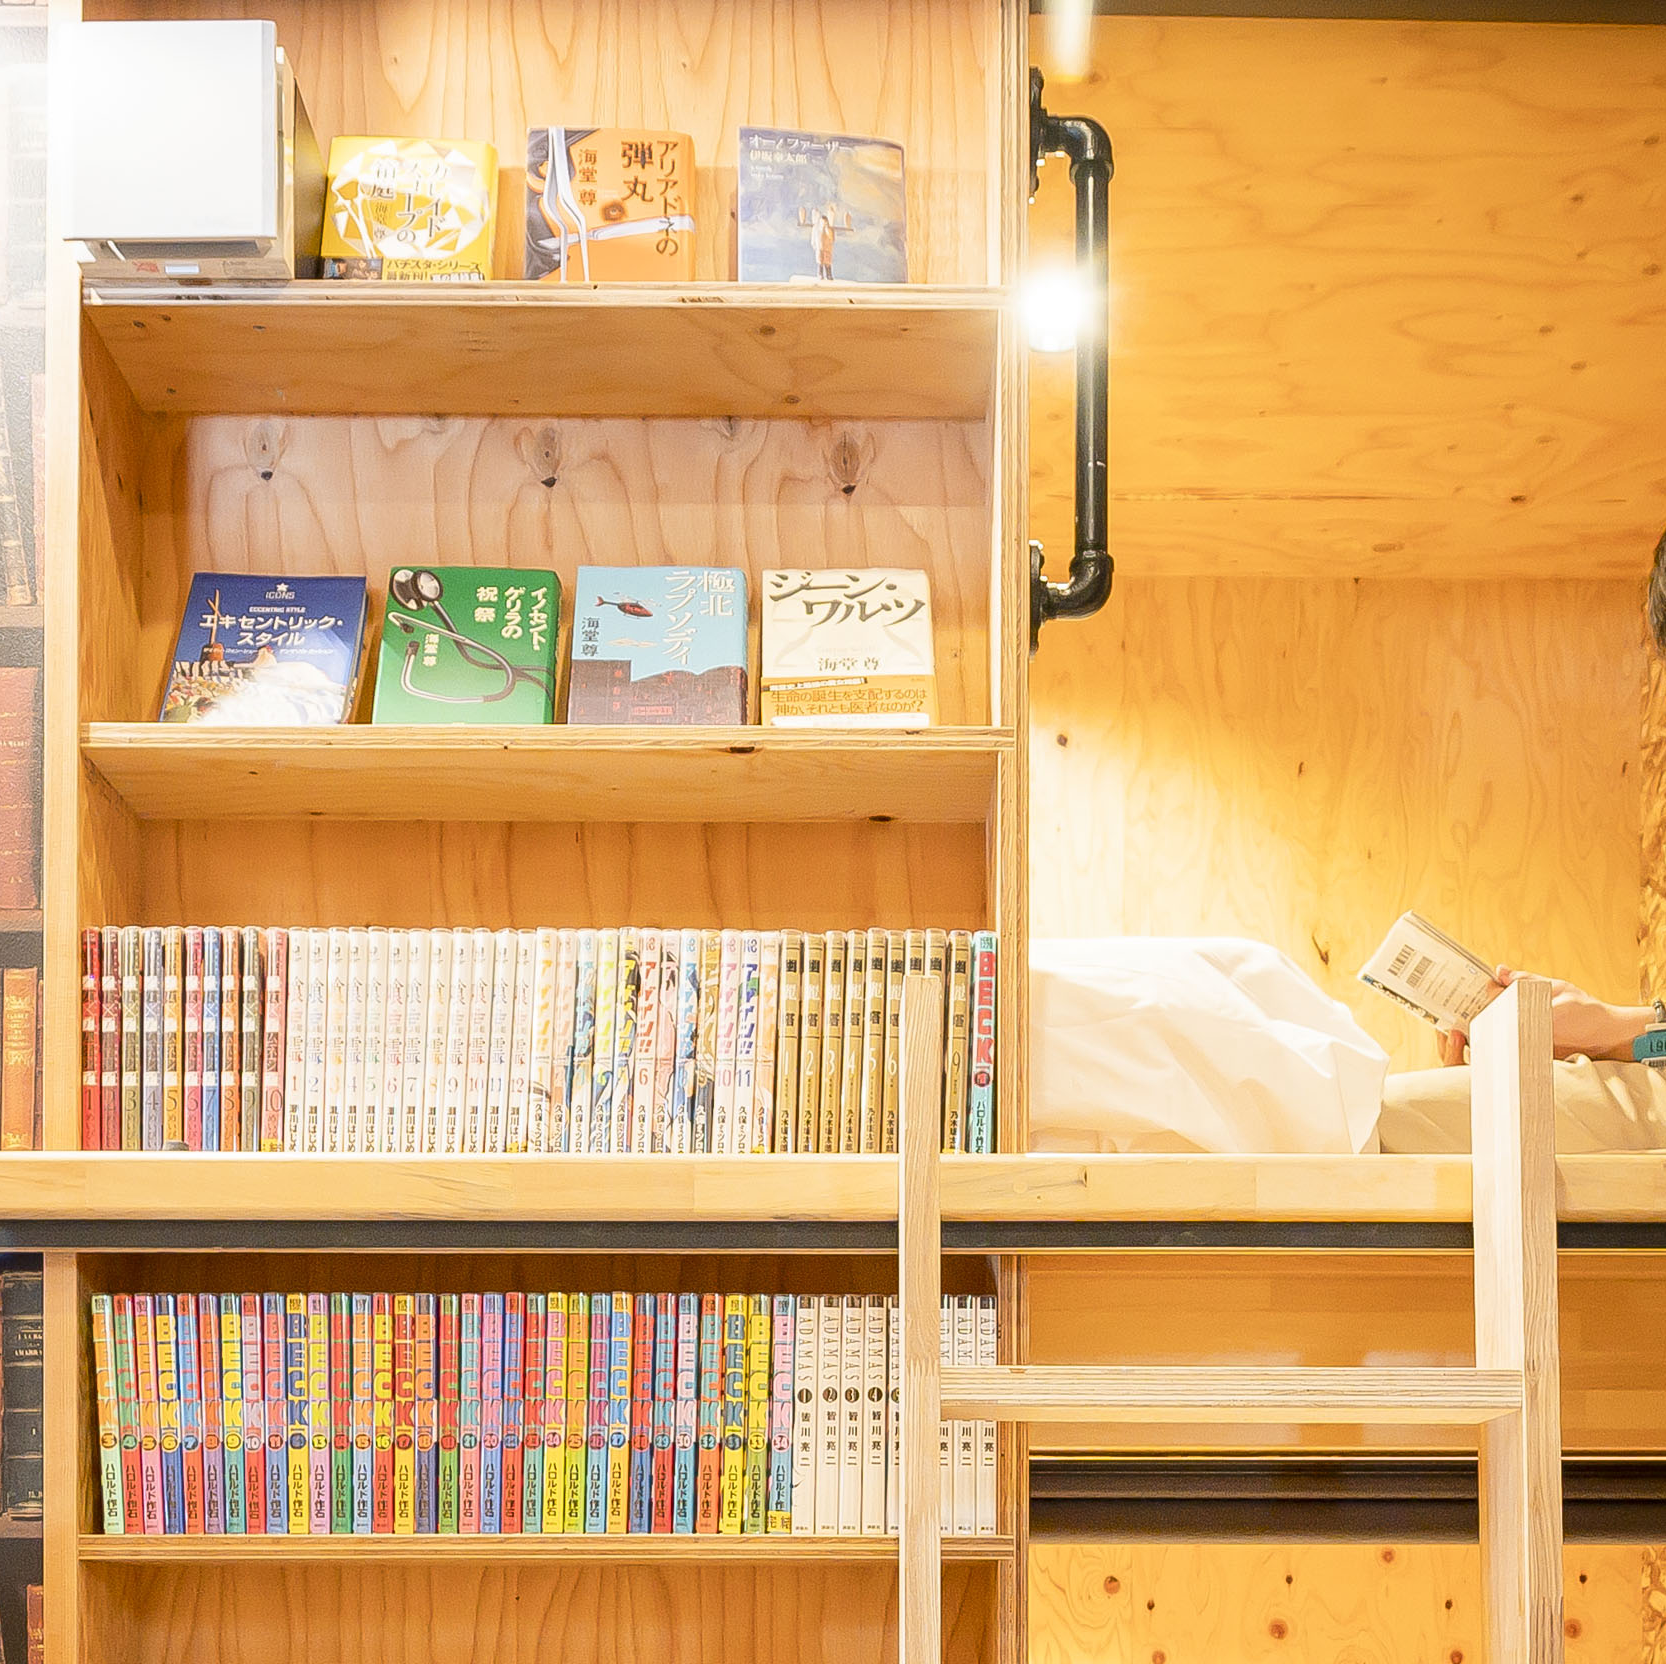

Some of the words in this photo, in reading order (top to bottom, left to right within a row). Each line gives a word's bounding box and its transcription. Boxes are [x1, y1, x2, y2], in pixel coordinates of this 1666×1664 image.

[578, 148, 597, 206] 海堂尊
[621, 141, 654, 202] 弾丸
[656, 140, 682, 256] アリアドネの
[473, 586, 499, 623] 祝祭
[501, 586, 526, 639] ゲリラの
[662, 570, 698, 665] ラプソディ
[697, 570, 735, 616] 極北
[802, 599, 925, 627] ワルツ
[237, 632, 306, 646] スタイル
[771, 688, 927, 702] 生命の誕生を支配するのは
[972, 951, 995, 1066] BECK
[736, 1068, 751, 1088] 11
[805, 1049, 815, 1076] 2
[166, 1089, 178, 1113] 5
[265, 1089, 281, 1113] 10
[156, 1314, 177, 1428] BECK
[610, 1312, 632, 1426] BECK
[772, 1313, 793, 1427] BECK
[824, 1314, 840, 1382] ADAMAS
[164, 1435, 177, 1449] 6
